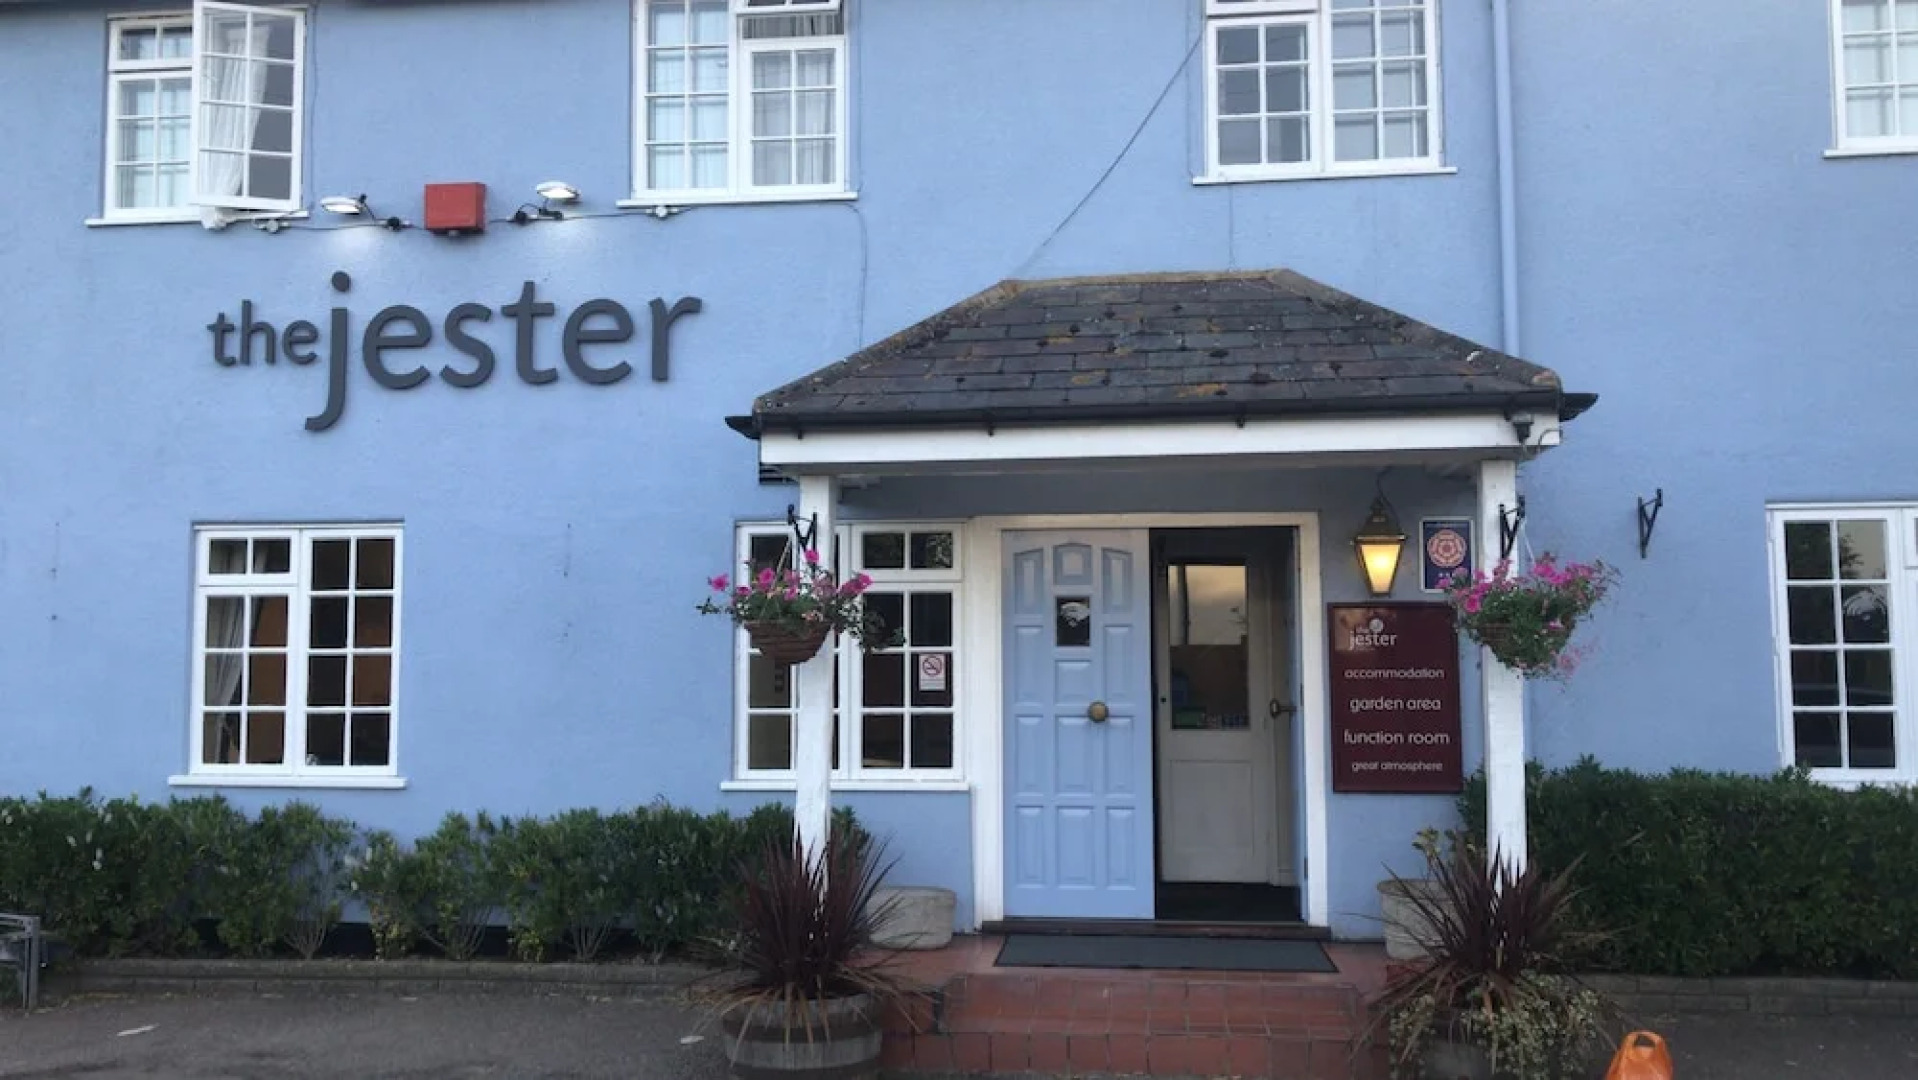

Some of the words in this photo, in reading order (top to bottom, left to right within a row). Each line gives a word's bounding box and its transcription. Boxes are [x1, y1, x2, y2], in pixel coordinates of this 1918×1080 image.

[207, 300, 319, 366] the
[305, 271, 702, 432] jester
[1349, 630, 1398, 651] jester
[1344, 667, 1445, 679] accommodation
[1350, 696, 1404, 713] garden
[1407, 699, 1441, 711] area
[1344, 729, 1404, 744] function
[1408, 732, 1451, 744] room
[1352, 762, 1379, 772] great
[1381, 761, 1443, 772] atmosphere
